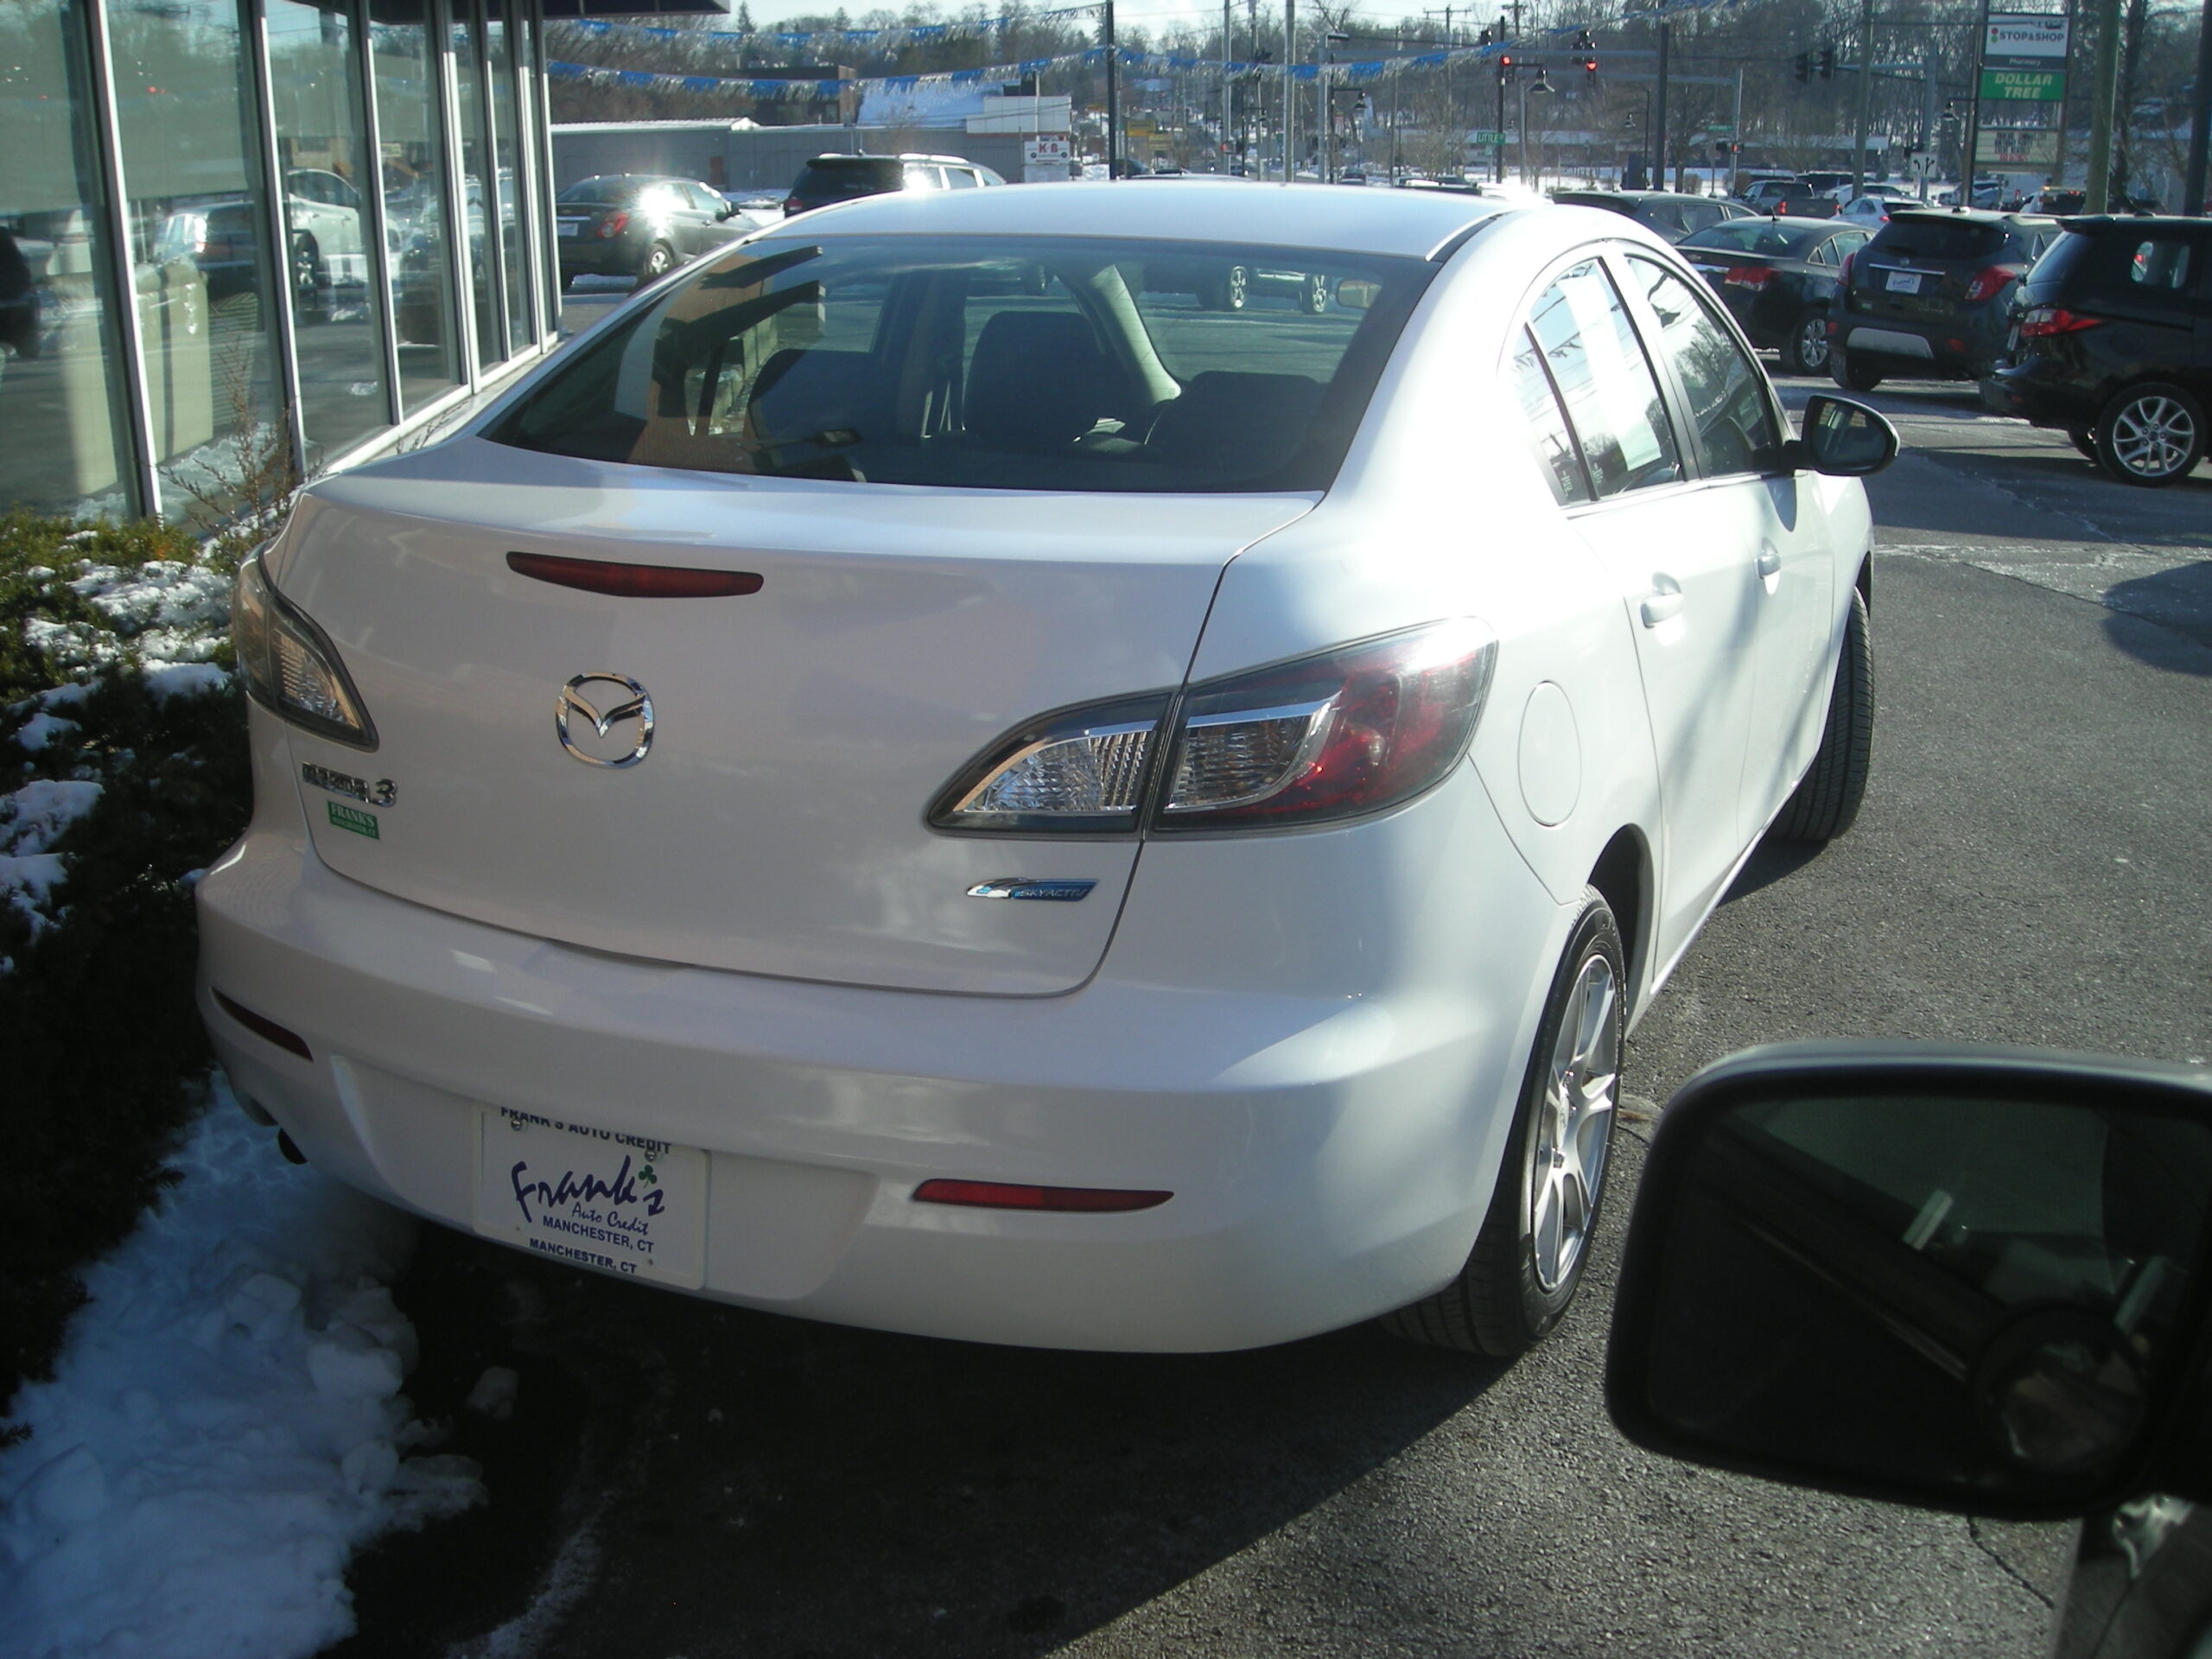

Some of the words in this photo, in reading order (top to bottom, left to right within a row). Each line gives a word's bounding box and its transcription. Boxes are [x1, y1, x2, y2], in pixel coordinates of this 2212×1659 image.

[1995, 73, 2052, 86] DOLLAR
[2005, 87, 2041, 99] TREE
[616, 1135, 671, 1154] CREDIT
[572, 1202, 602, 1223] Auto
[607, 1211, 649, 1235] Credit
[543, 1216, 633, 1249] MANCHESTER,
[637, 1240, 654, 1253] CT
[529, 1238, 616, 1269] MANCHESTER,
[620, 1262, 636, 1274] CT
